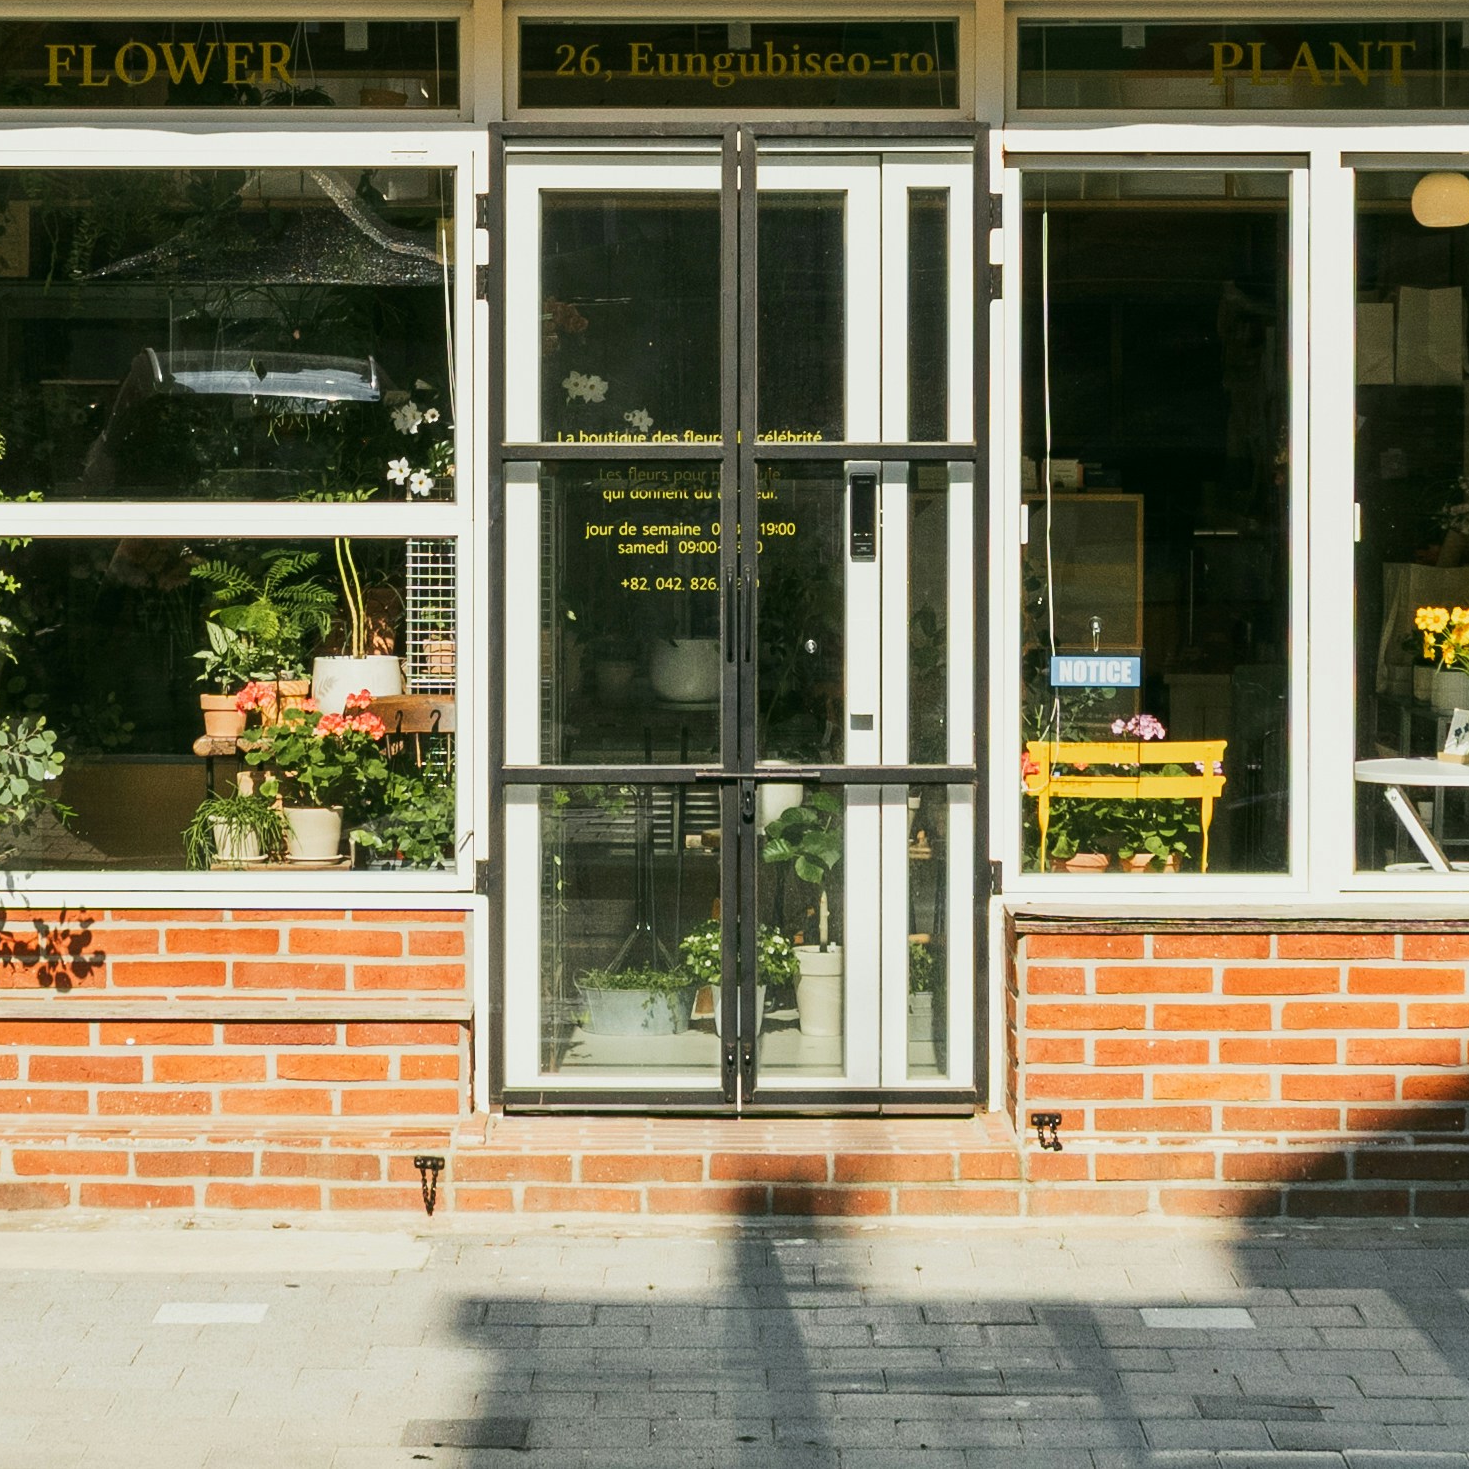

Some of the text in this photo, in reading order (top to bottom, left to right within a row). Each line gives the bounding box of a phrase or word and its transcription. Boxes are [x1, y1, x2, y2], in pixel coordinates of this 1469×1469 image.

[45, 41, 295, 87] FLOWER
[554, 40, 935, 88] 26, Eungubiseo-ro
[1209, 41, 1416, 87] PLANT
[557, 431, 575, 443] La
[652, 430, 678, 443] des
[627, 467, 669, 481] fleurs
[585, 521, 615, 540] jour
[618, 521, 637, 537] de
[642, 522, 702, 537] semaine
[617, 540, 669, 555] samedi
[1057, 659, 1133, 685] NOTICE
